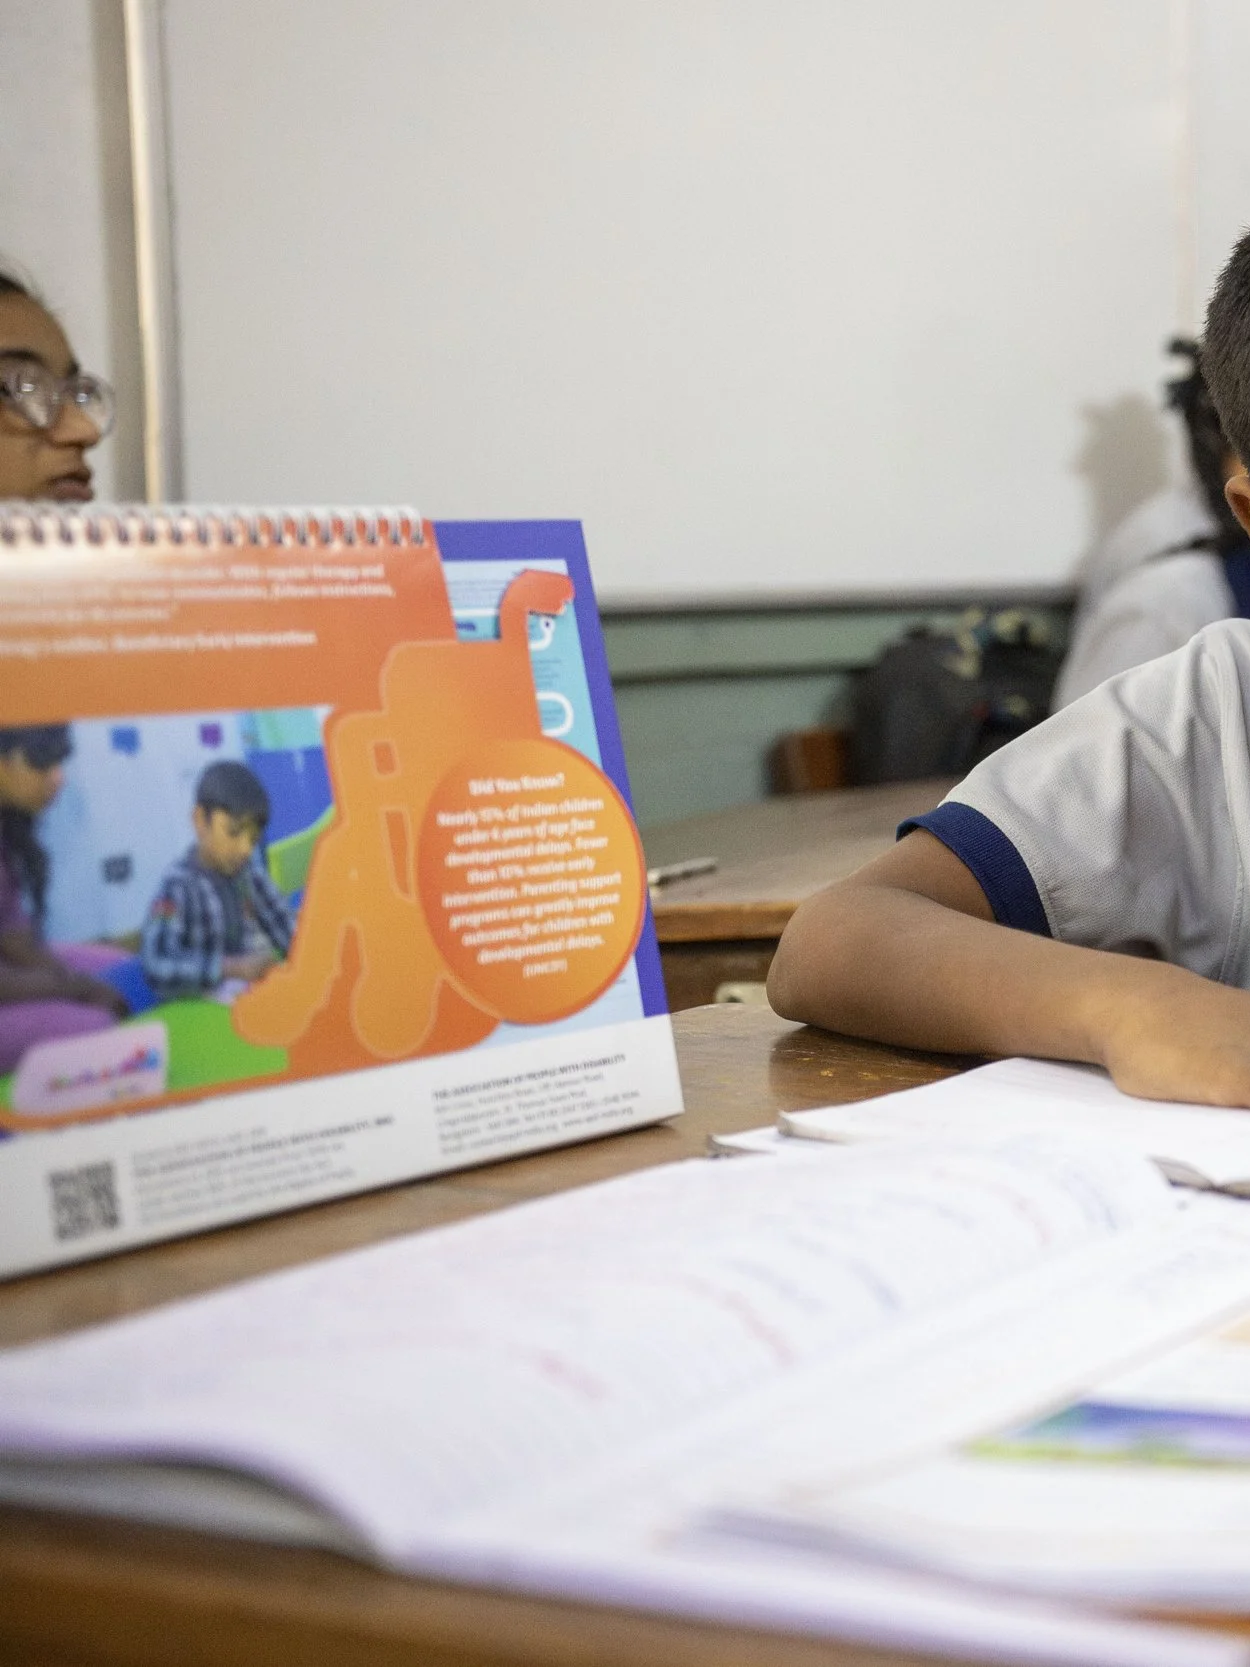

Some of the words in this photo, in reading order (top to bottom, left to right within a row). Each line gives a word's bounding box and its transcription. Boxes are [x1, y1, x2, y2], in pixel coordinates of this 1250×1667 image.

[469, 779, 495, 796] Did
[497, 778, 520, 793] You
[522, 773, 565, 789] Know?
[437, 811, 478, 827] Nearly
[507, 805, 520, 822] of
[522, 802, 558, 818] Indian
[560, 798, 604, 815] children
[455, 829, 490, 846] under
[503, 826, 533, 843] years
[446, 844, 534, 867] developmental
[576, 837, 608, 850] Fewer
[468, 870, 497, 884] than
[522, 880, 577, 896] Parenting
[580, 871, 622, 888] support
[511, 905, 531, 918] can
[535, 899, 574, 917] greatly
[576, 893, 620, 909] improve
[542, 917, 588, 933] children
[590, 911, 615, 926] with
[478, 942, 564, 965] developmental
